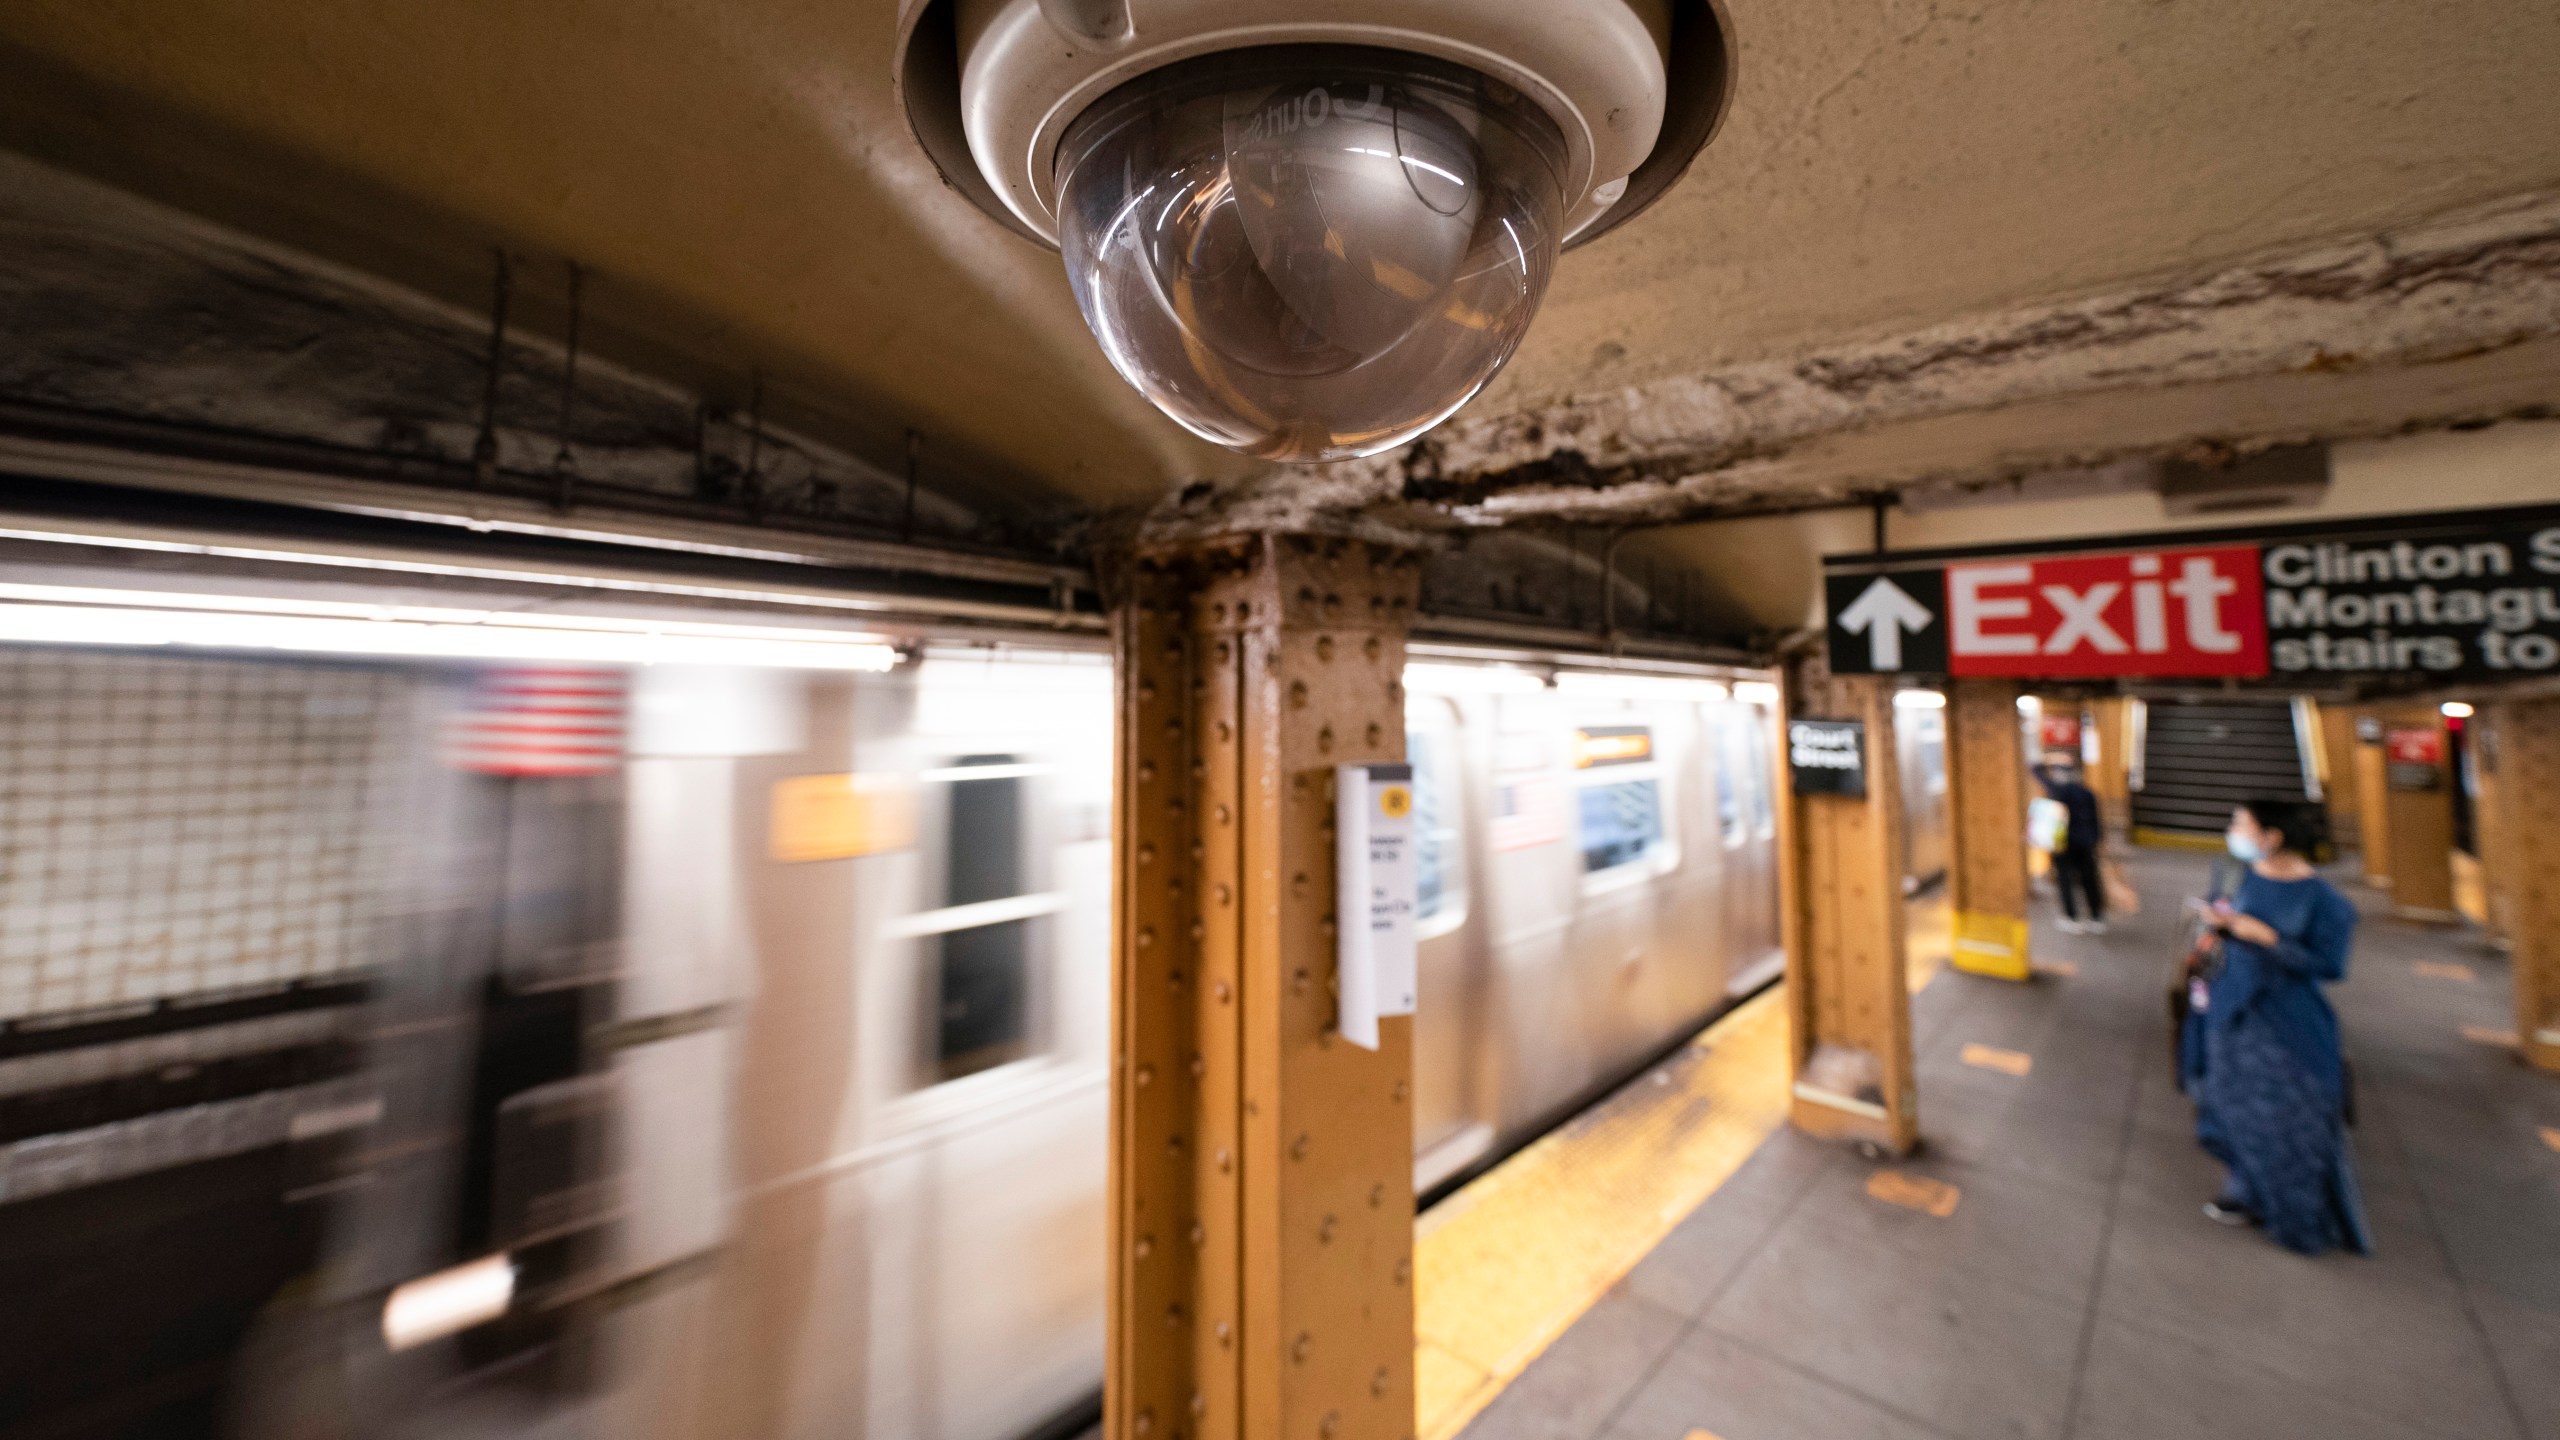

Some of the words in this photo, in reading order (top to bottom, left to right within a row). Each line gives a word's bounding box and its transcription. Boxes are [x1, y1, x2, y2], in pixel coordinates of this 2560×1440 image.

[2264, 541, 2512, 588] Clinton
[1949, 554, 2243, 656] Exit
[2272, 629, 2464, 671] stairs
[2480, 629, 2560, 670] to
